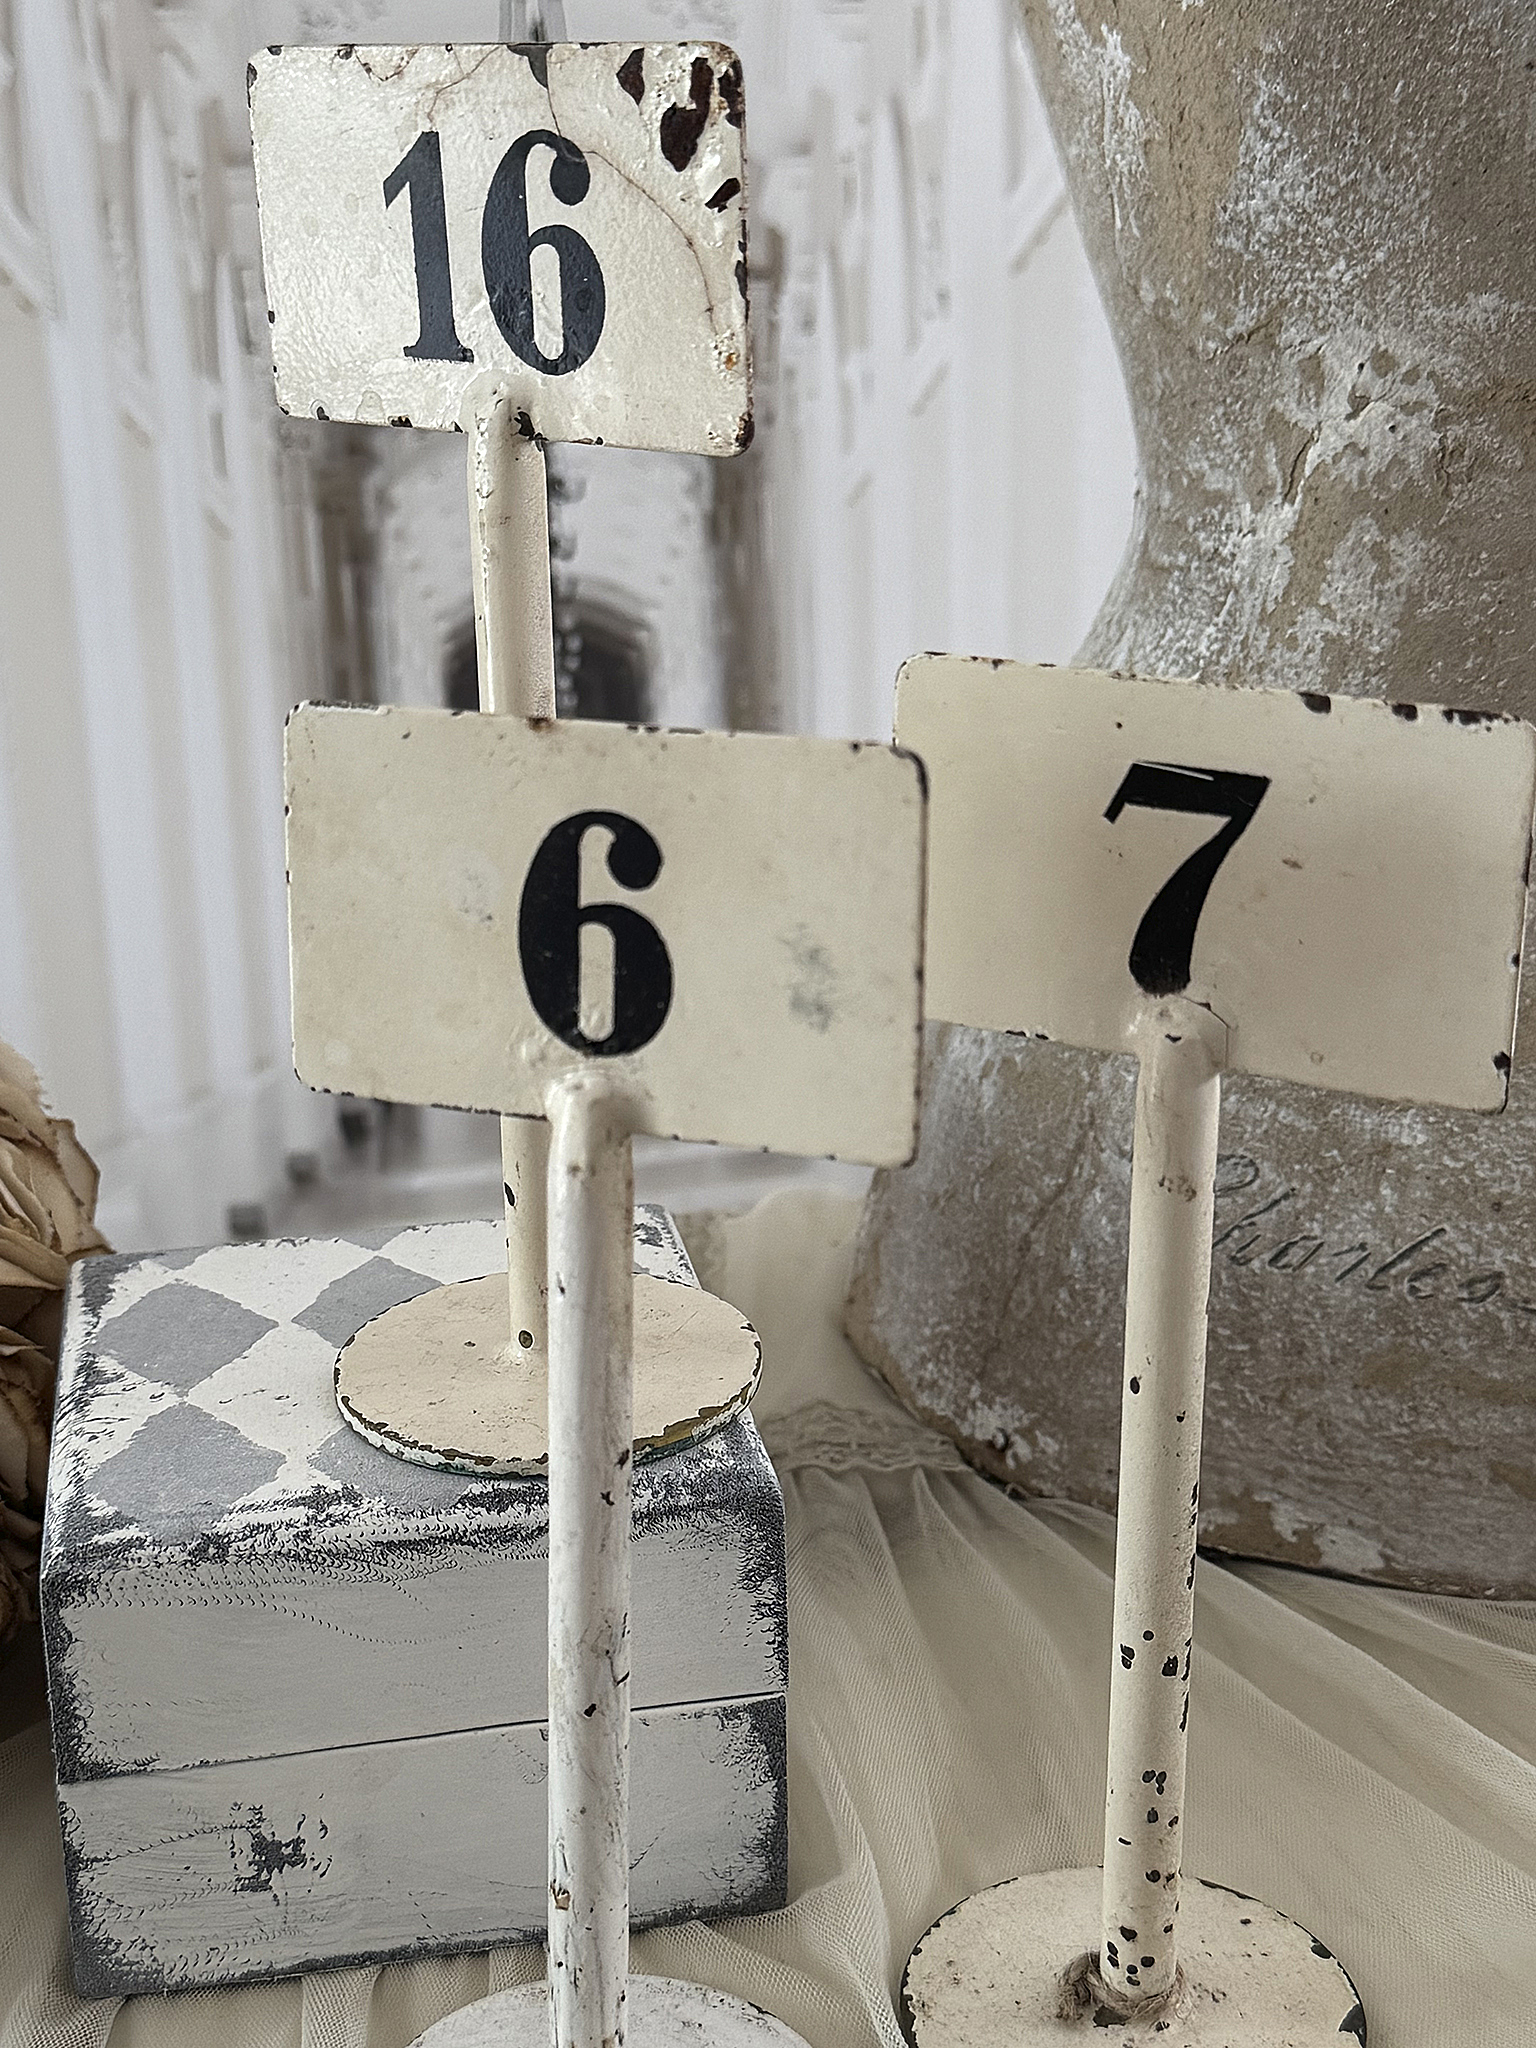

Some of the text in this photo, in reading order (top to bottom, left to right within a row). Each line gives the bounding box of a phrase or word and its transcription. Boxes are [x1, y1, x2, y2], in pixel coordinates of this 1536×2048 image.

[382, 129, 606, 377] 16
[517, 809, 674, 1058] 6
[1102, 760, 1273, 998] 7
